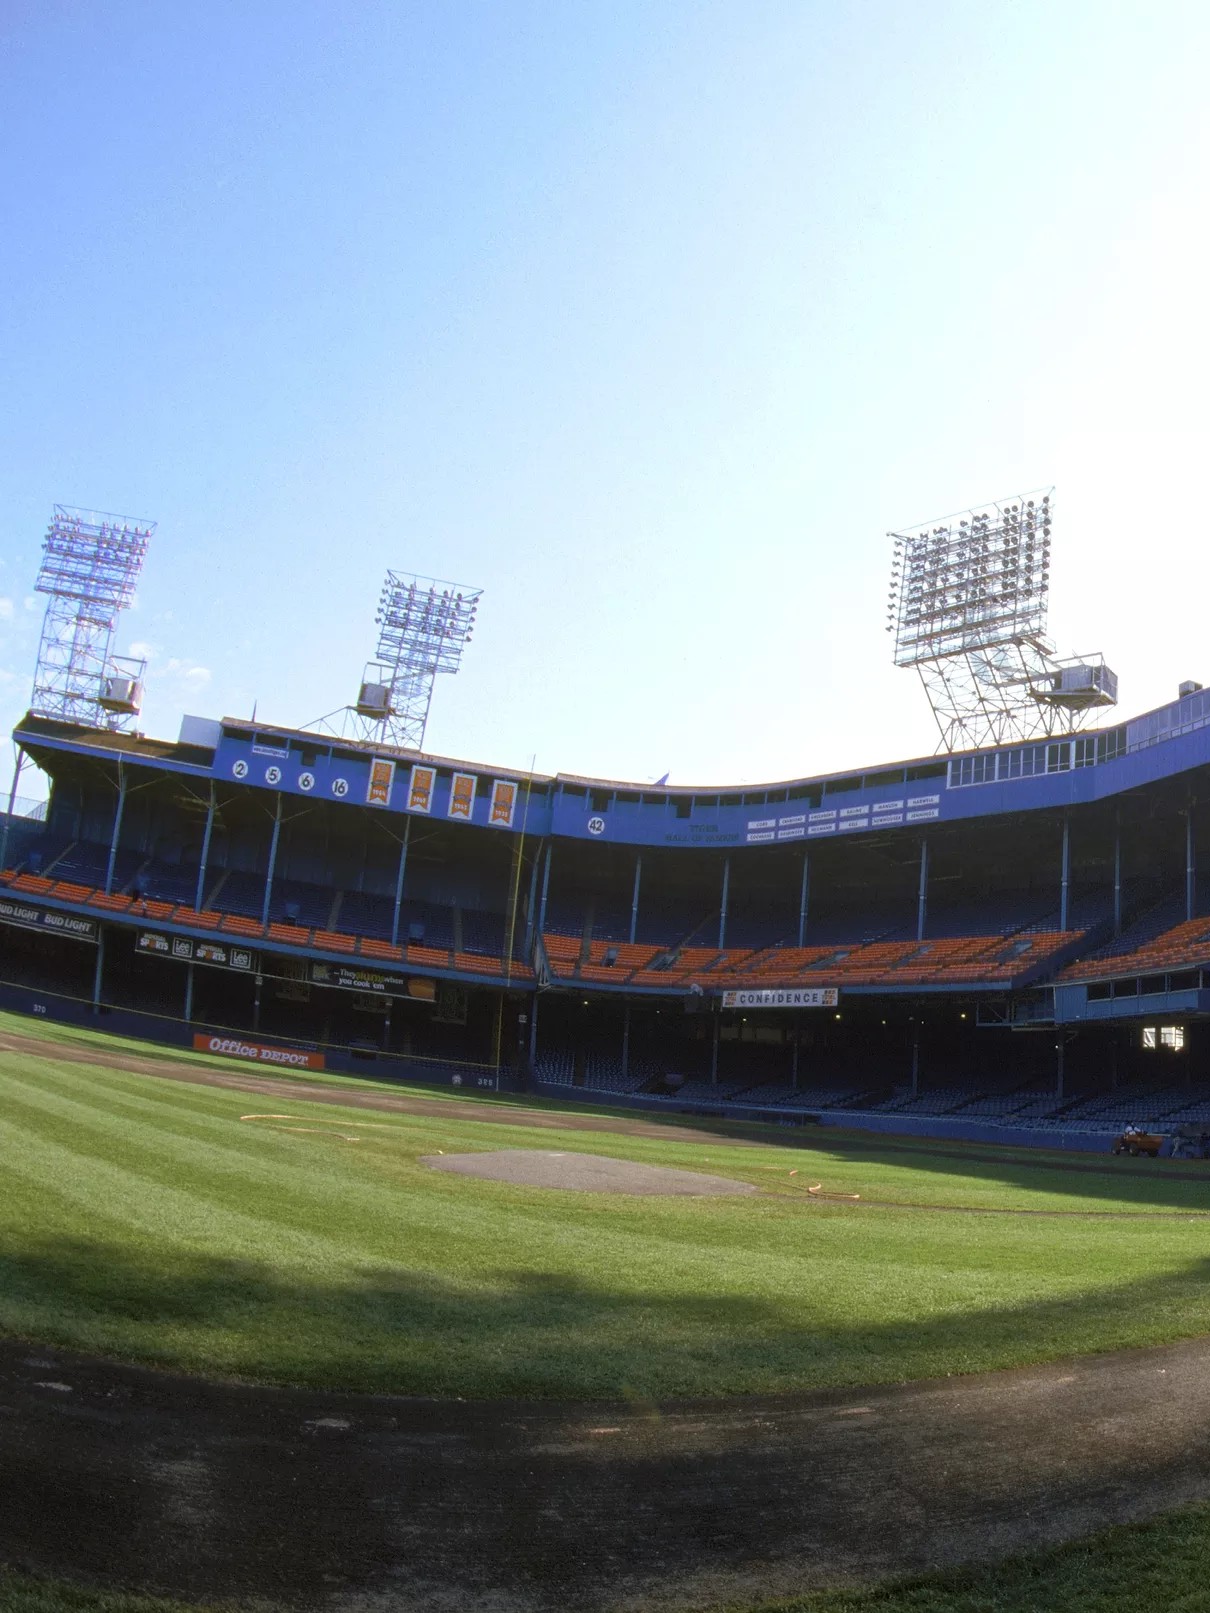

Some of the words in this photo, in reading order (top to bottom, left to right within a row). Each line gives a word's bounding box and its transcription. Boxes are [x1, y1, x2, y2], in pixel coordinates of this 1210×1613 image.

[236, 763, 245, 775] 2
[268, 769, 277, 780] 5
[302, 775, 310, 787] 6
[334, 781, 345, 793] 16
[589, 820, 603, 832] 42
[13, 907, 39, 921] LIGHT
[44, 913, 64, 925] BUD
[64, 918, 92, 932] LIGHT
[338, 977, 353, 986] you
[353, 979, 370, 989] cook
[740, 993, 819, 1004] CONFIDENCE
[33, 1004, 46, 1013] 370
[209, 1037, 257, 1058] Office
[260, 1049, 309, 1066] DEPOT
